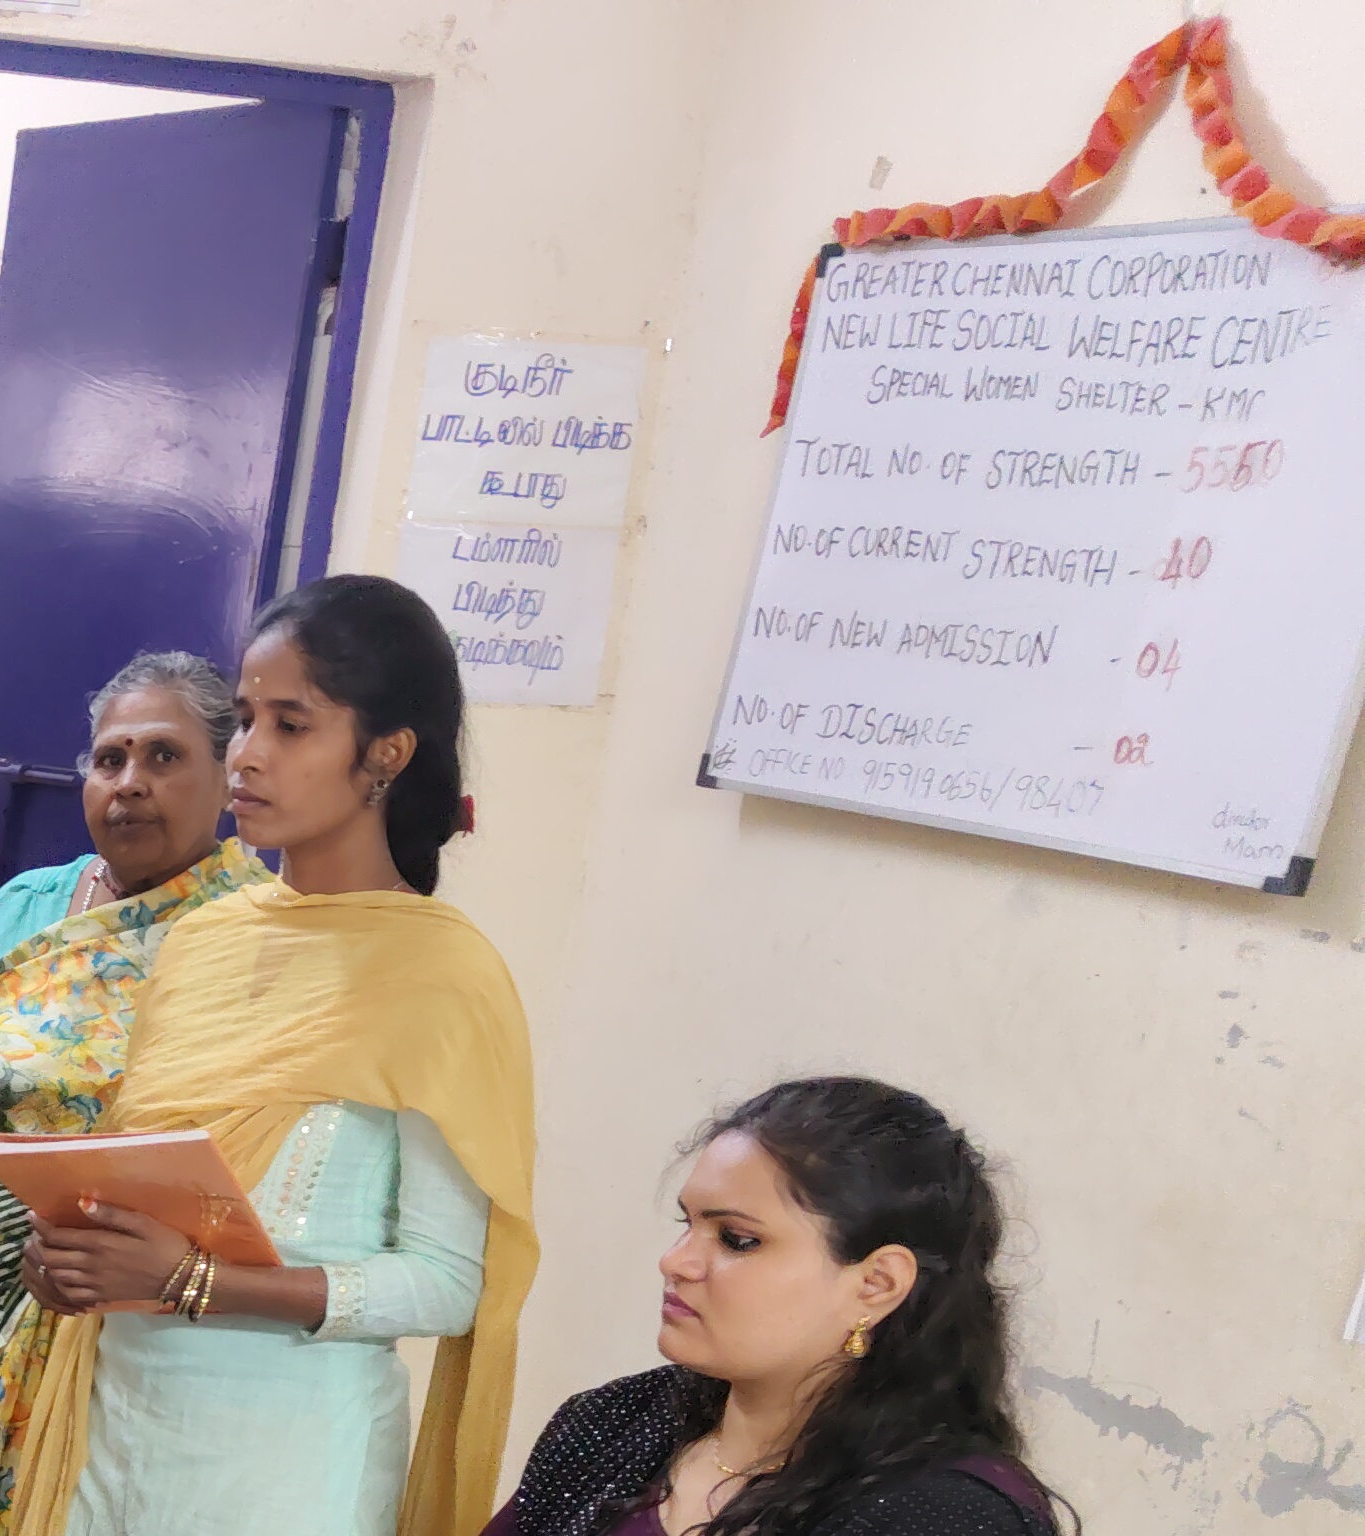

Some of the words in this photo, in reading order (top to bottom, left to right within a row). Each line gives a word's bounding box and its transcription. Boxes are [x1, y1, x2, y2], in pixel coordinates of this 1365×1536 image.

[826, 259, 949, 302] GREATER
[951, 258, 1083, 299] CHENNAI
[1087, 249, 1272, 301] CORPORATION
[821, 312, 882, 352] NEW
[886, 308, 951, 350] LIFE
[952, 309, 1051, 352] SOCIAL
[1067, 314, 1207, 368] WELFARE
[1210, 303, 1334, 370] CENTRE
[464, 352, 575, 399] குடிநீர்
[1055, 376, 1171, 417] SHELTER
[795, 436, 875, 480] TOTAL
[986, 448, 1141, 490] STRENGTH
[847, 525, 961, 562] CURRENT
[962, 538, 1119, 588] STRENGTH
[451, 580, 547, 631] பிடித்து
[828, 611, 888, 650] NEW
[896, 622, 1060, 668] ADMISSION
[1135, 640, 1183, 693] 04
[815, 701, 973, 747] DISCHARGE
